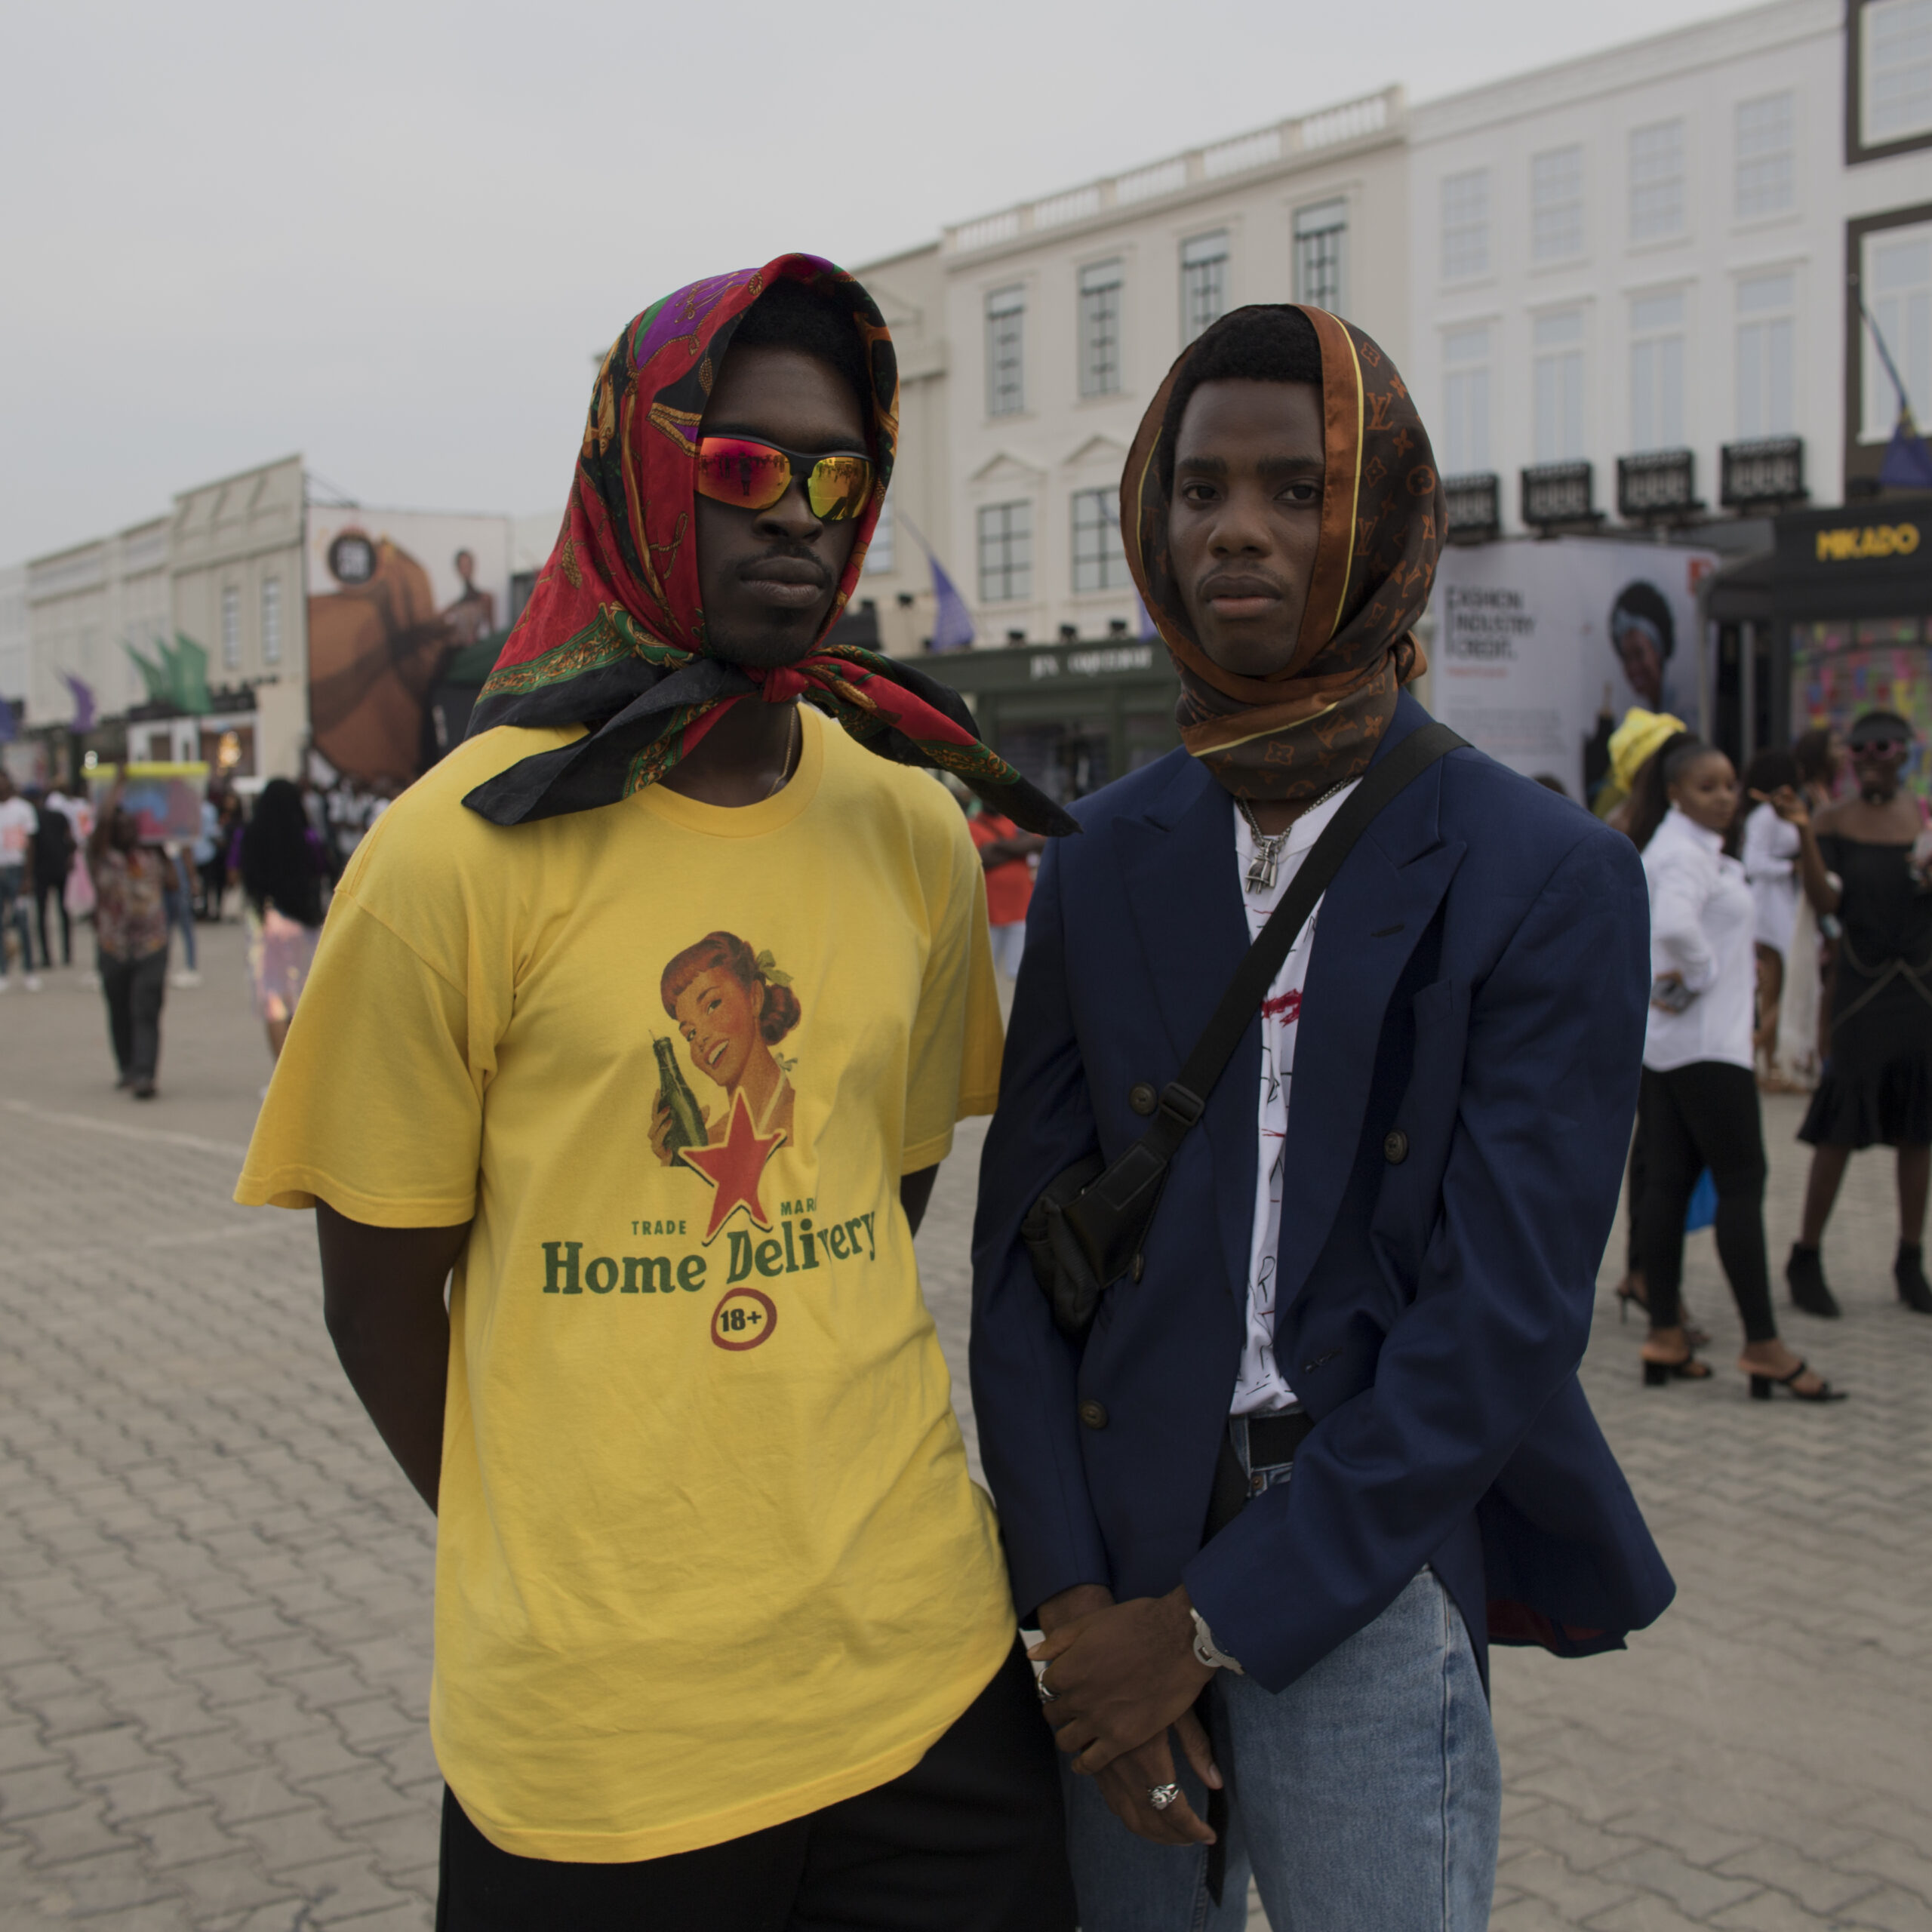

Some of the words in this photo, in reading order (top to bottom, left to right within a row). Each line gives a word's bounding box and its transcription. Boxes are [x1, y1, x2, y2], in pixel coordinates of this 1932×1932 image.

[1817, 524, 1920, 561] MIKADO
[1455, 612, 1536, 635] INDUSTRY
[632, 1220, 687, 1235] TRADE
[780, 1198, 817, 1217] MAR
[541, 1241, 707, 1294] Home
[726, 1211, 876, 1284] Delivery
[720, 1309, 762, 1333] 18+
